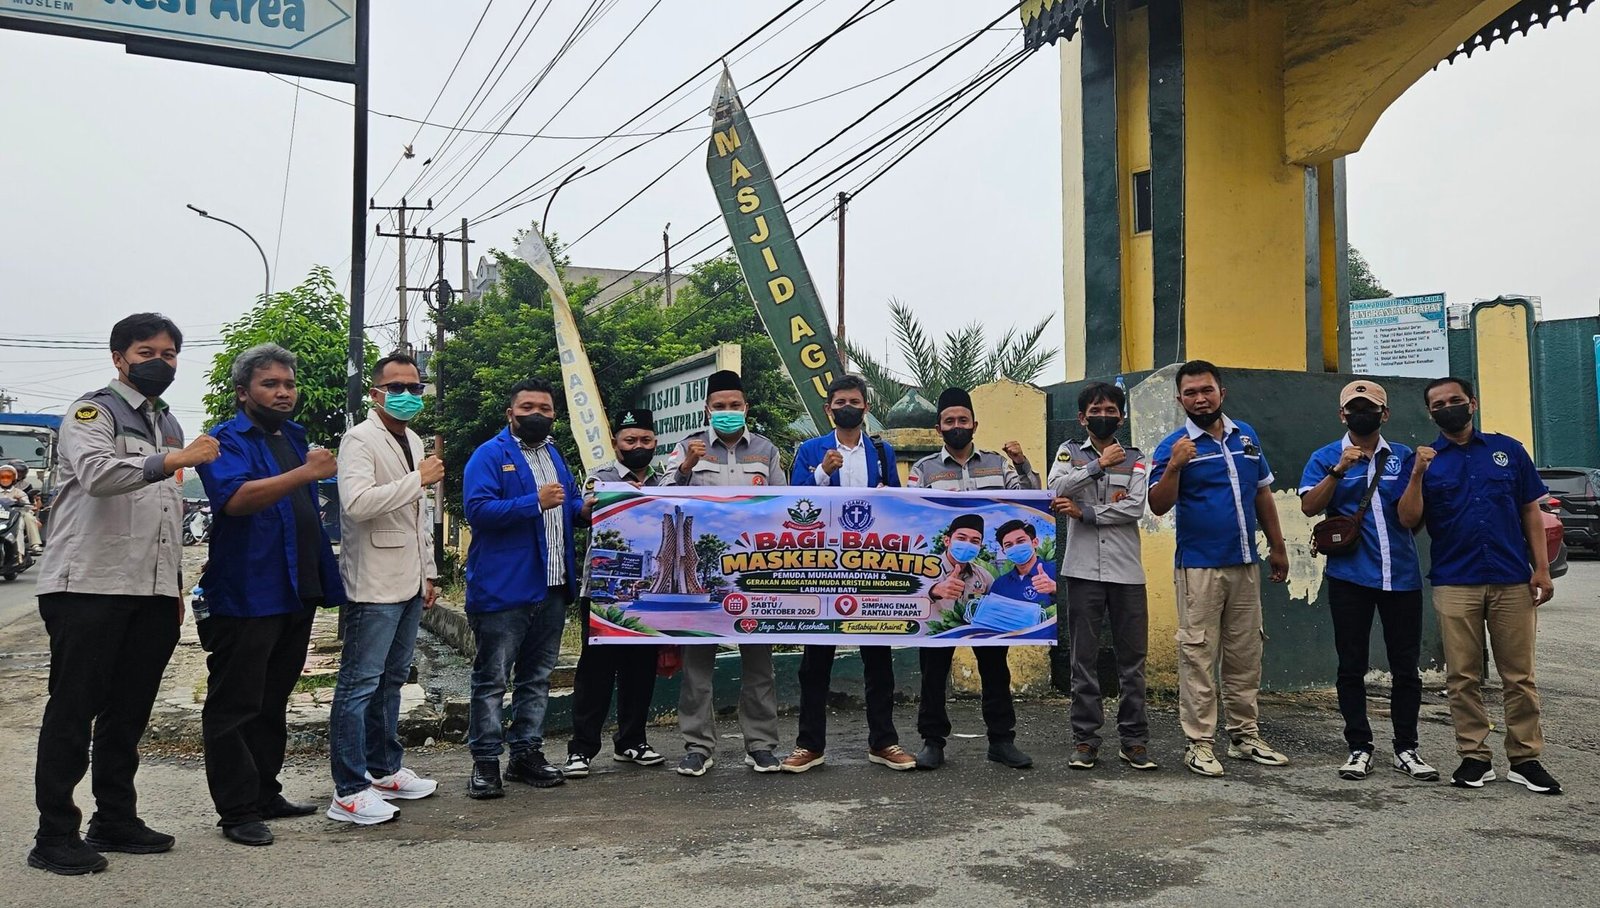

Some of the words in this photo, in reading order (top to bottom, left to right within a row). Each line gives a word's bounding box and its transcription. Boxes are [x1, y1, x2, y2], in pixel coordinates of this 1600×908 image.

[713, 124, 795, 305] MASJID
[721, 550, 839, 575] MASKER
[841, 550, 941, 578] GRATIS
[808, 572, 879, 580] MUHAMMADIYAH
[881, 572, 887, 580] &
[759, 621, 776, 632] Jaga
[776, 621, 797, 630] Selalu
[797, 621, 830, 631] Kesehatan
[880, 622, 904, 631] Khairat
